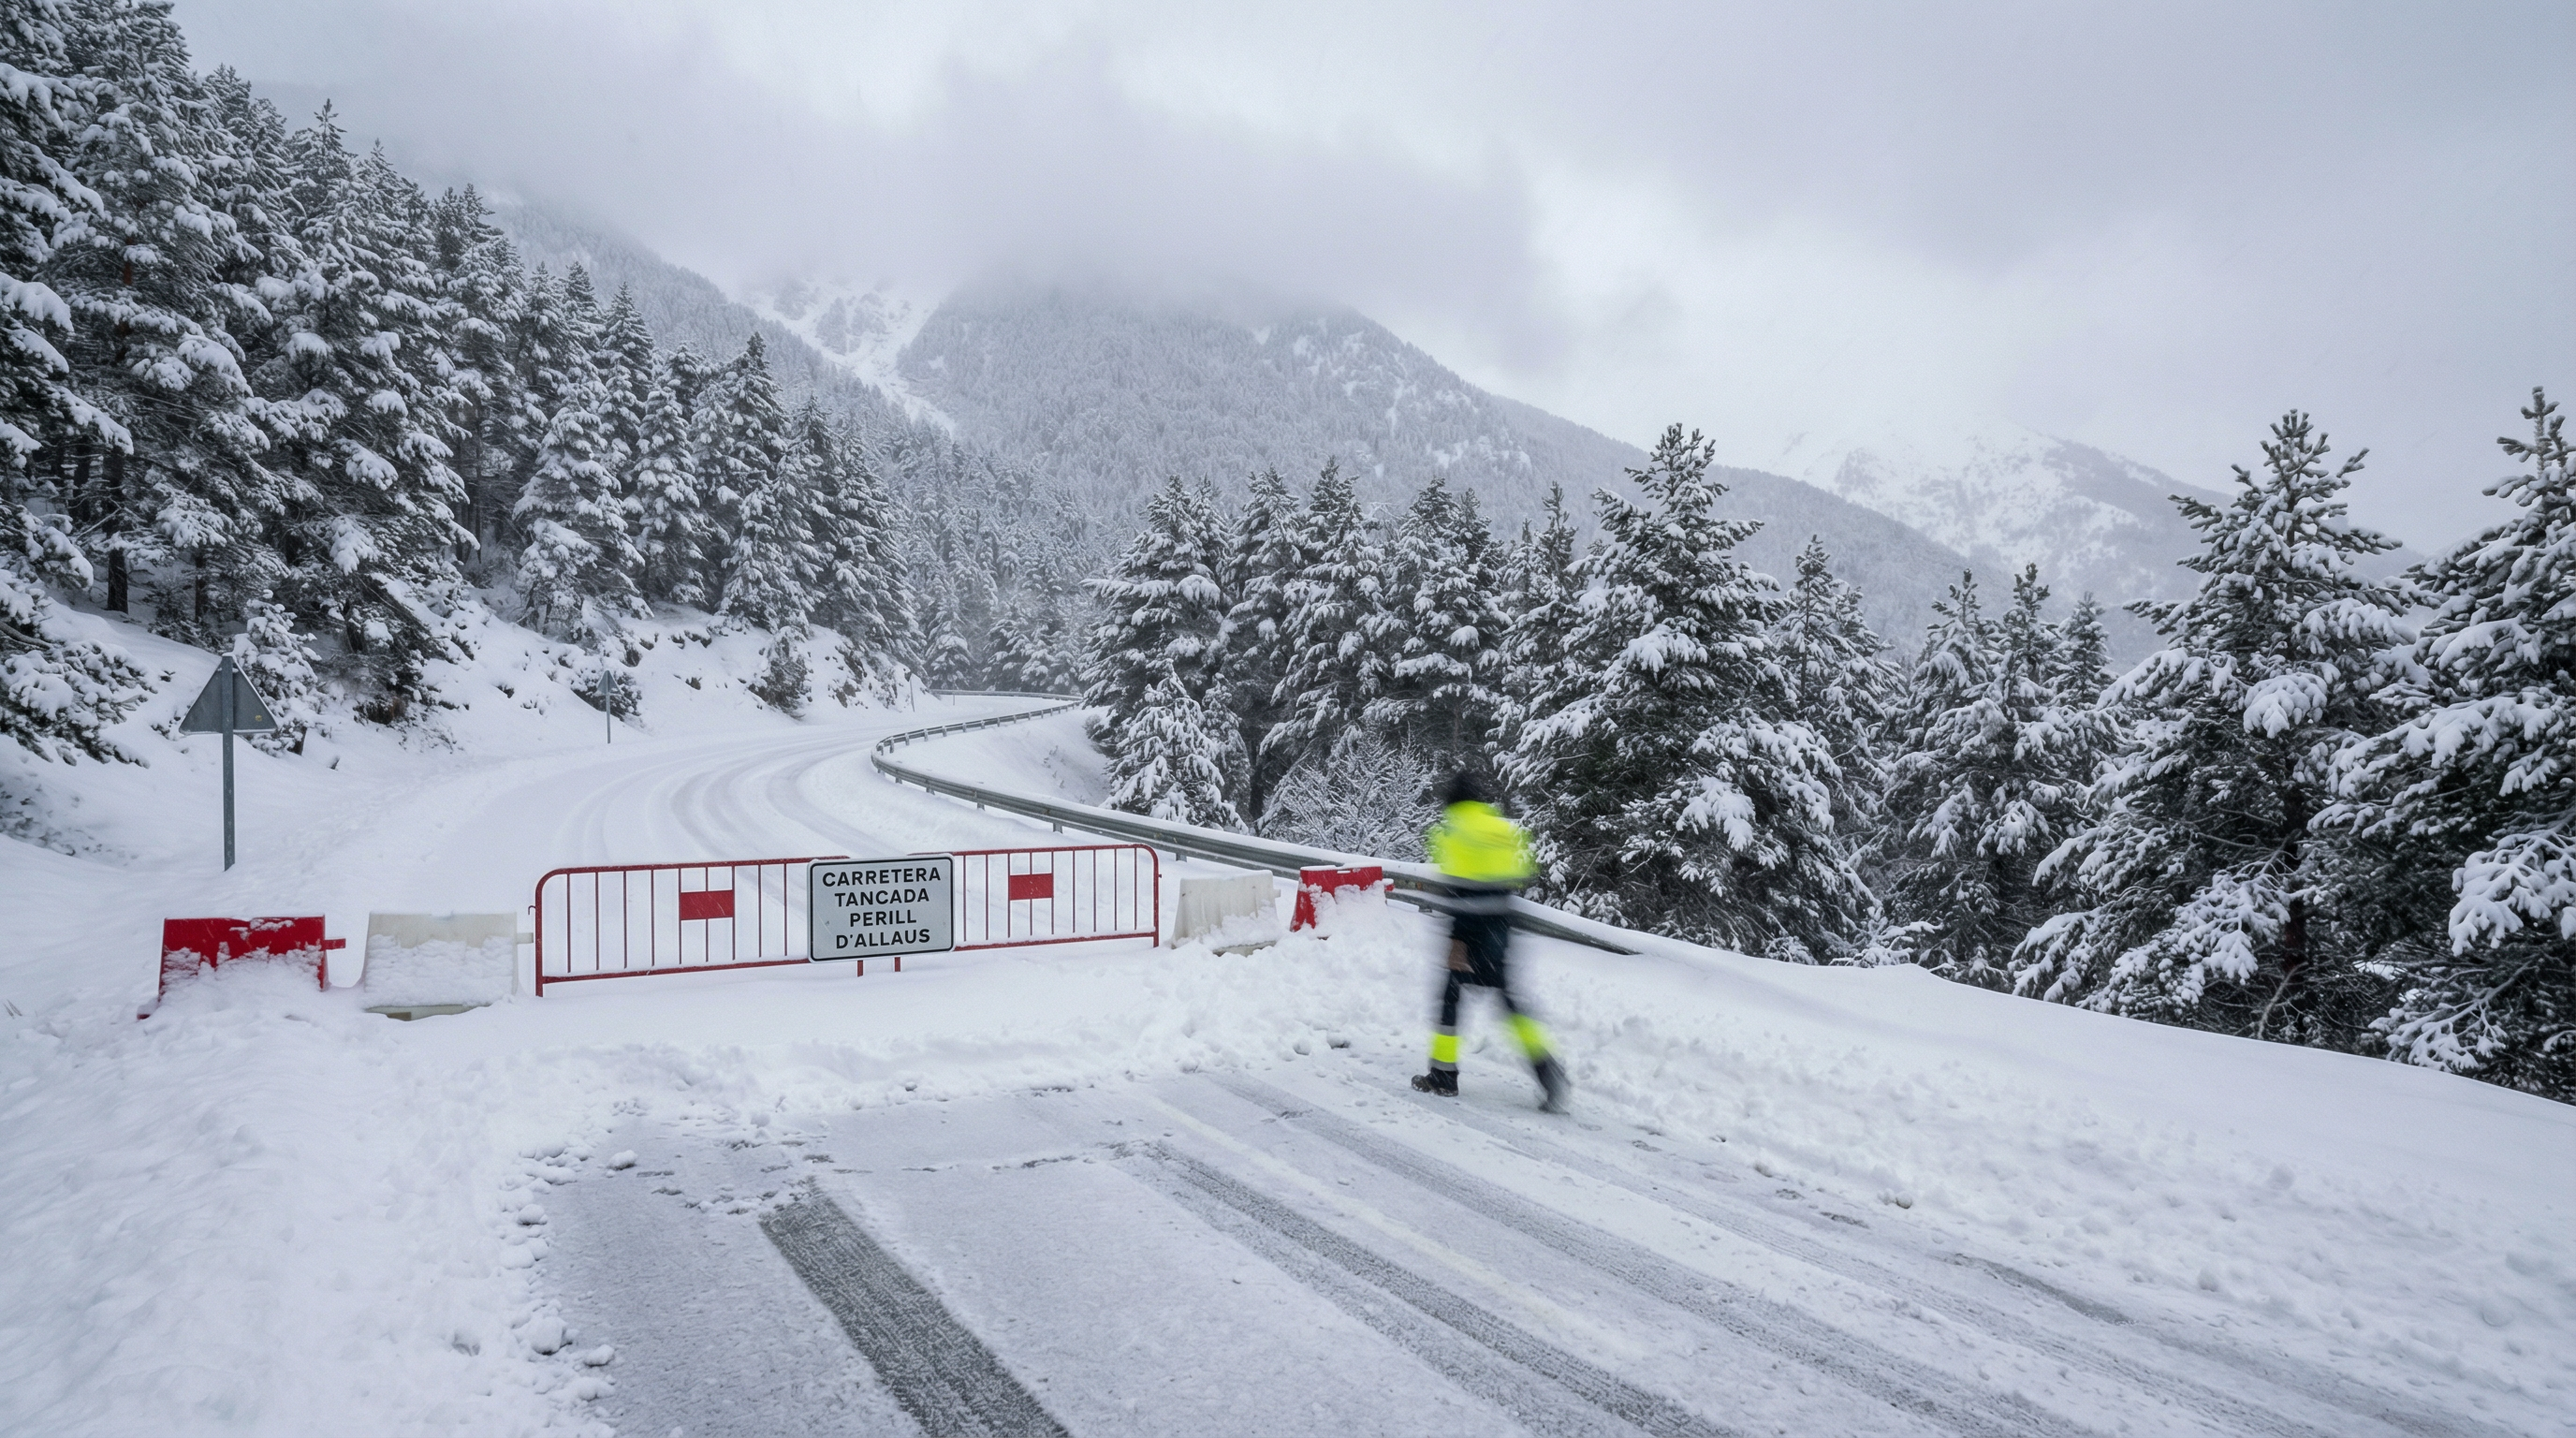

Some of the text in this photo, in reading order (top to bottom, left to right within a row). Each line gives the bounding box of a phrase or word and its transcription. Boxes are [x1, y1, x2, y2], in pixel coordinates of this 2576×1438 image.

[822, 867, 942, 887] CARRETERA
[834, 888, 929, 907] TANCADA
[850, 909, 917, 928] PERILL
[836, 929, 930, 949] D'ALLAUS
